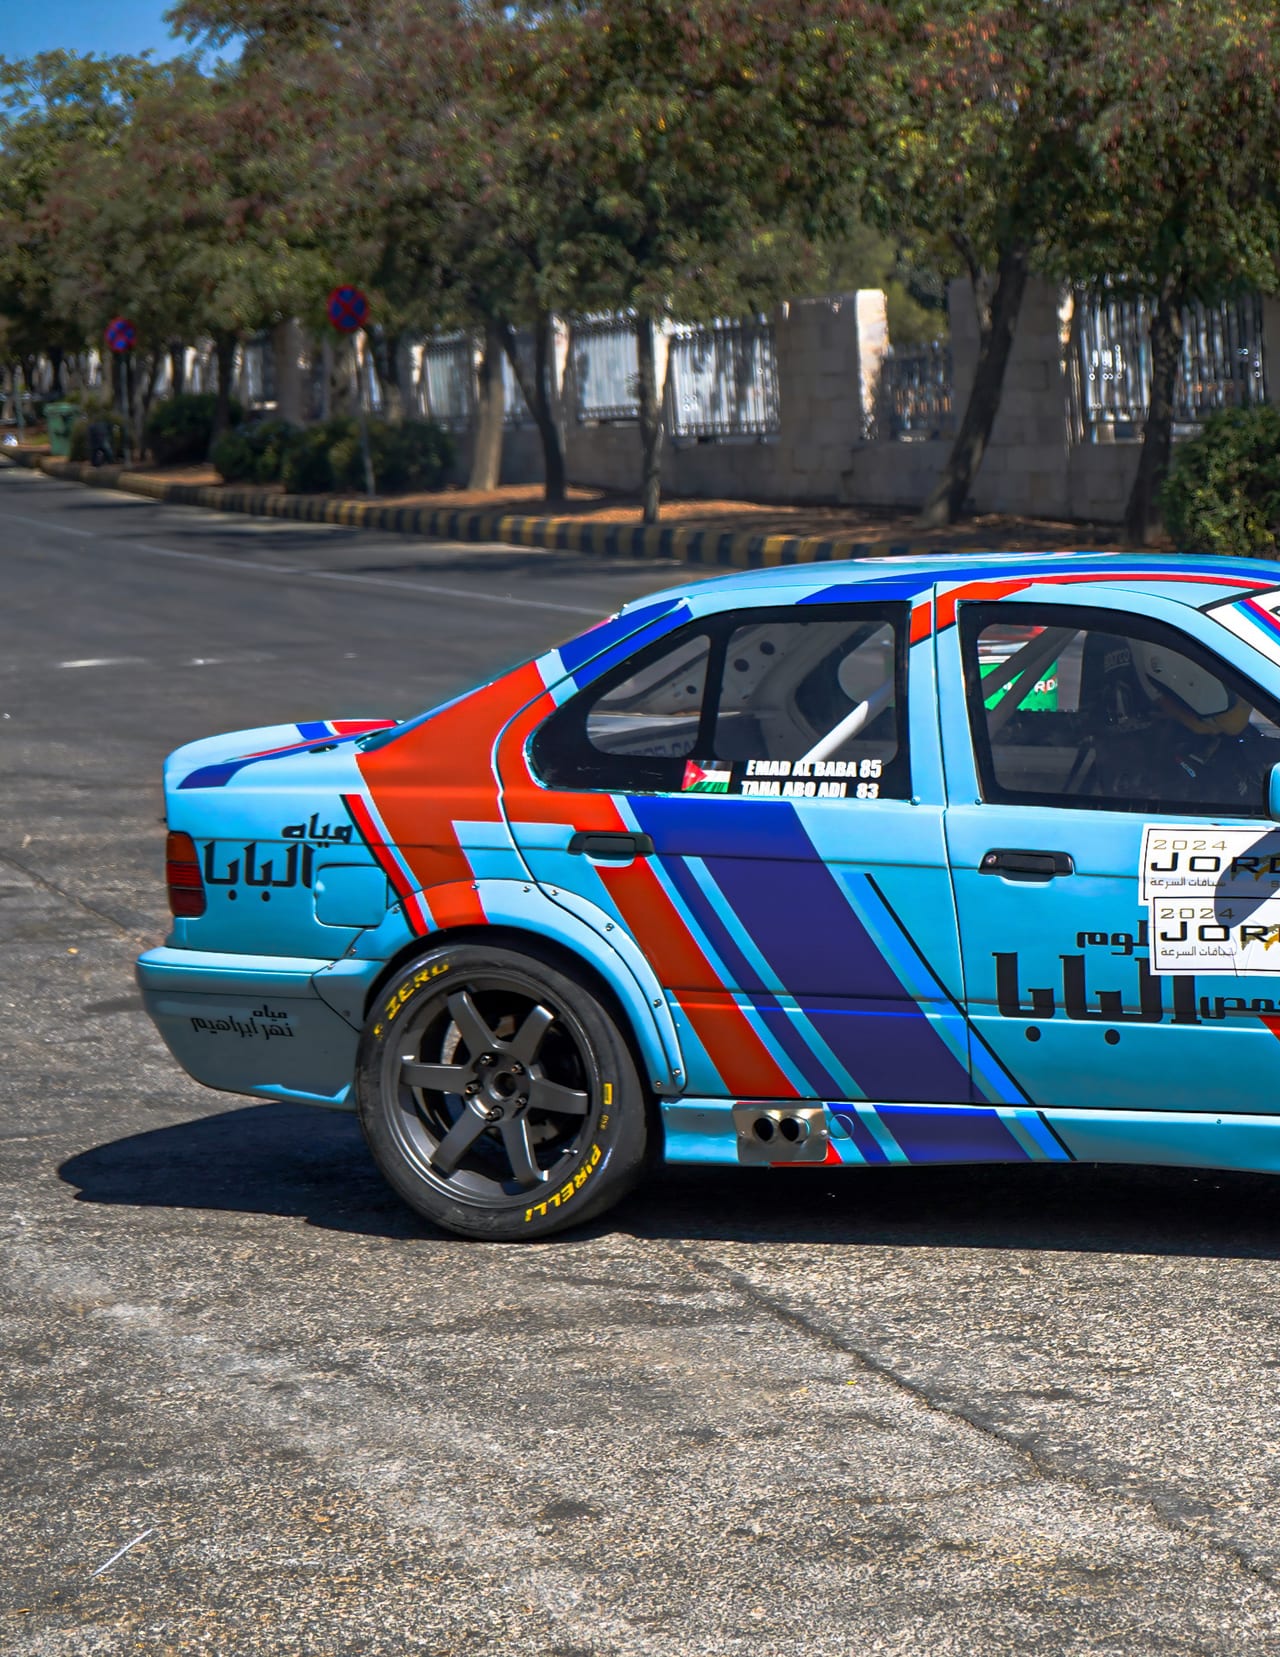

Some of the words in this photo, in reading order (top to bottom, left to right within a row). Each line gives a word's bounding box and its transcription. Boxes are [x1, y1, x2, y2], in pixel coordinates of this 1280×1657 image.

[746, 760, 792, 777] EMAD
[792, 760, 812, 777] AL
[813, 761, 857, 777] BABA
[859, 759, 883, 778] 85
[741, 780, 781, 797] TAHA
[817, 782, 847, 798] ADI
[856, 782, 879, 799] 83
[282, 812, 353, 848] مياه
[1152, 839, 1228, 851] 2024
[203, 841, 315, 902] البابا
[1150, 877, 1186, 890] السرعة
[1160, 908, 1235, 920] 2024
[1160, 946, 1197, 960] السرعة
[992, 951, 1202, 1046] البابا
[252, 1004, 288, 1022] مياه
[525, 1144, 602, 1222] PIRELLI
